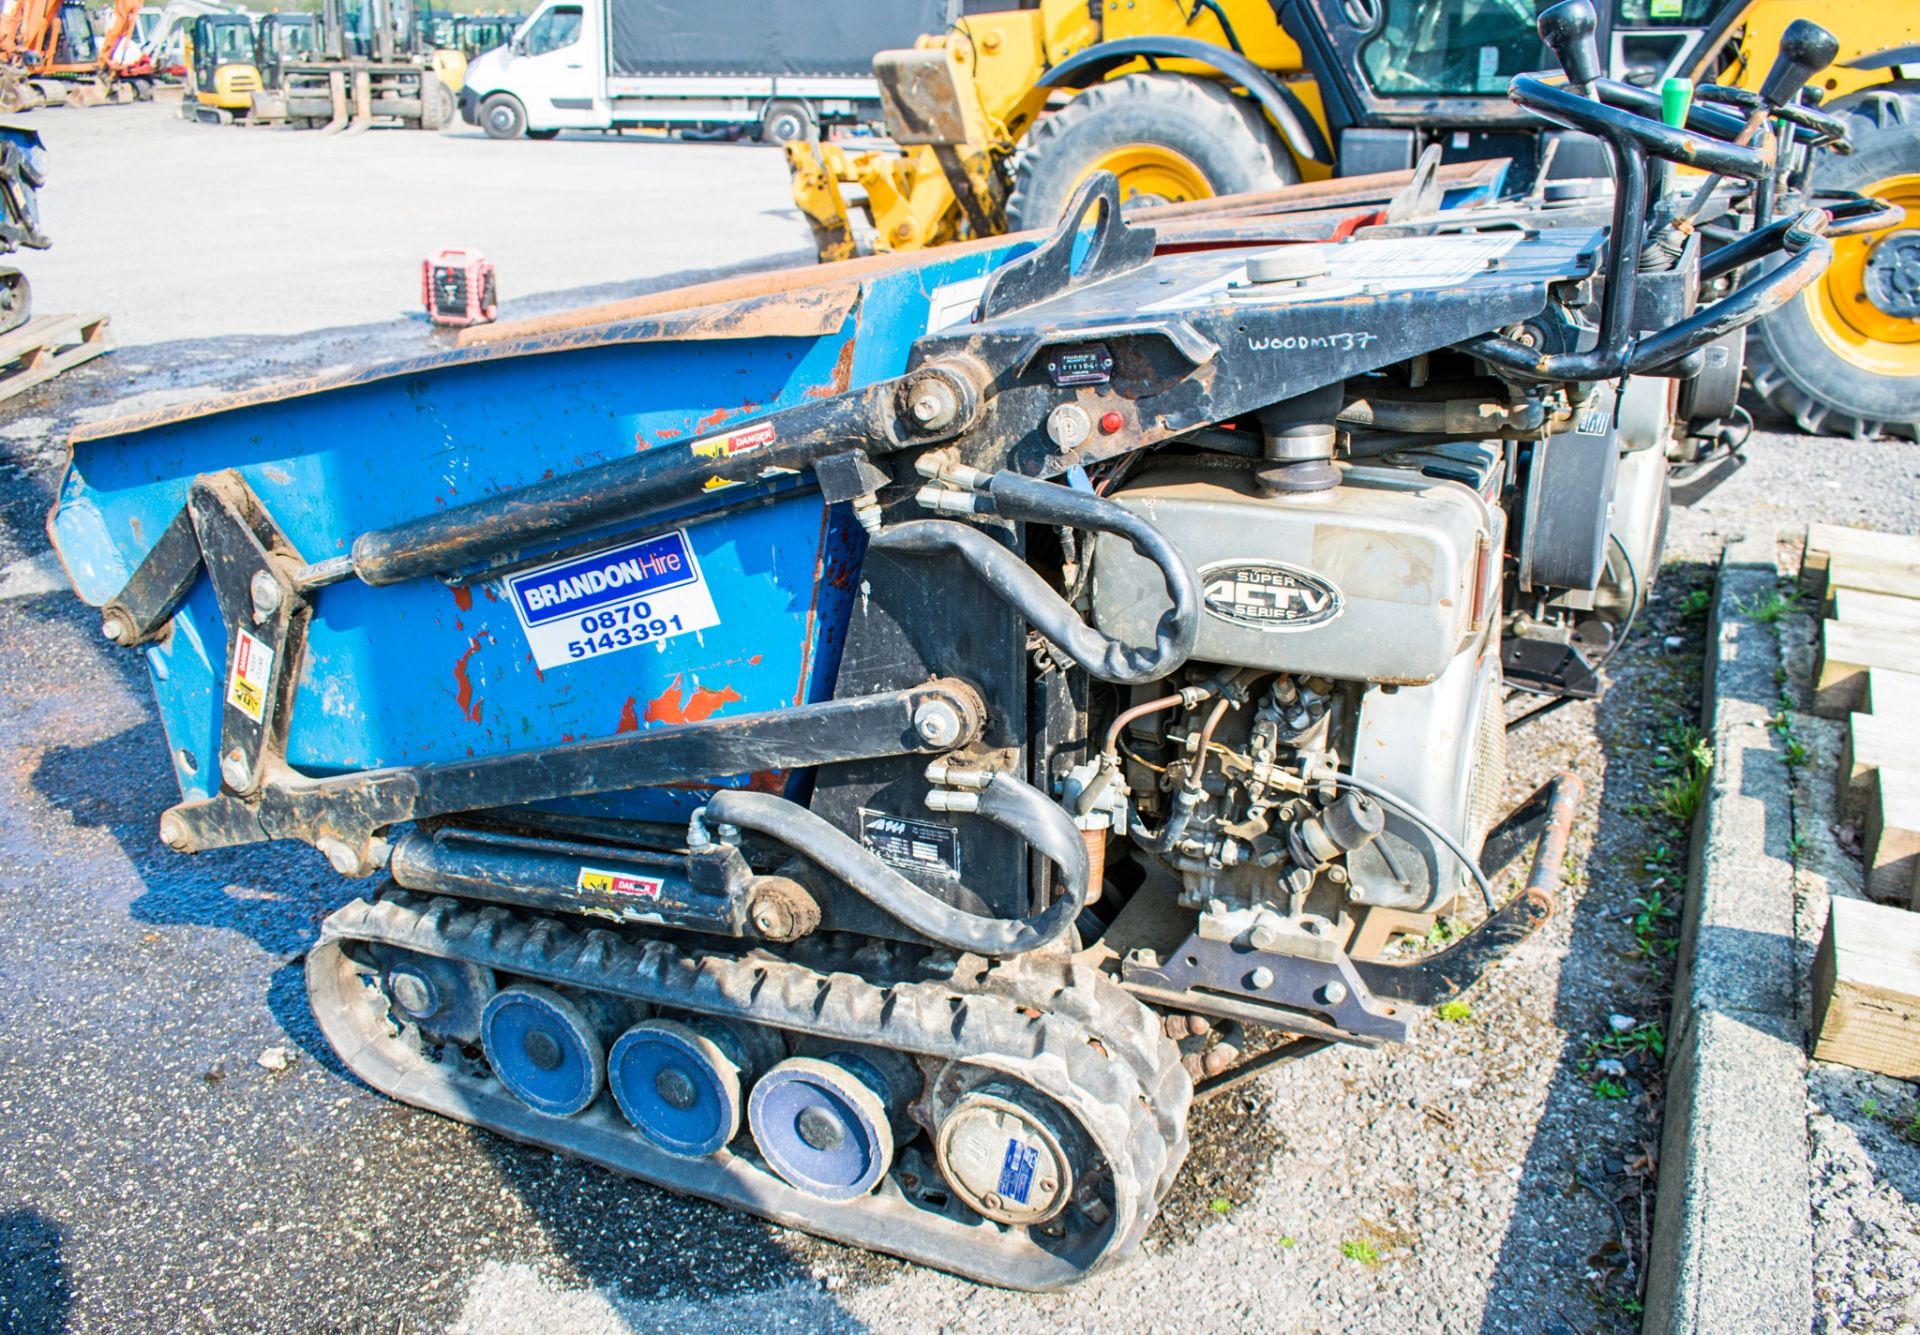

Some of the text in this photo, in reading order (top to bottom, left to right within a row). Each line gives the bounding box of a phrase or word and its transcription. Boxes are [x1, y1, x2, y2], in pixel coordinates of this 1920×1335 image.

[735, 430, 772, 446] DANGER
[1236, 571, 1296, 587] SUPER
[580, 601, 652, 634] 0870
[568, 614, 683, 658] 5143391
[618, 881, 651, 893] DANR
